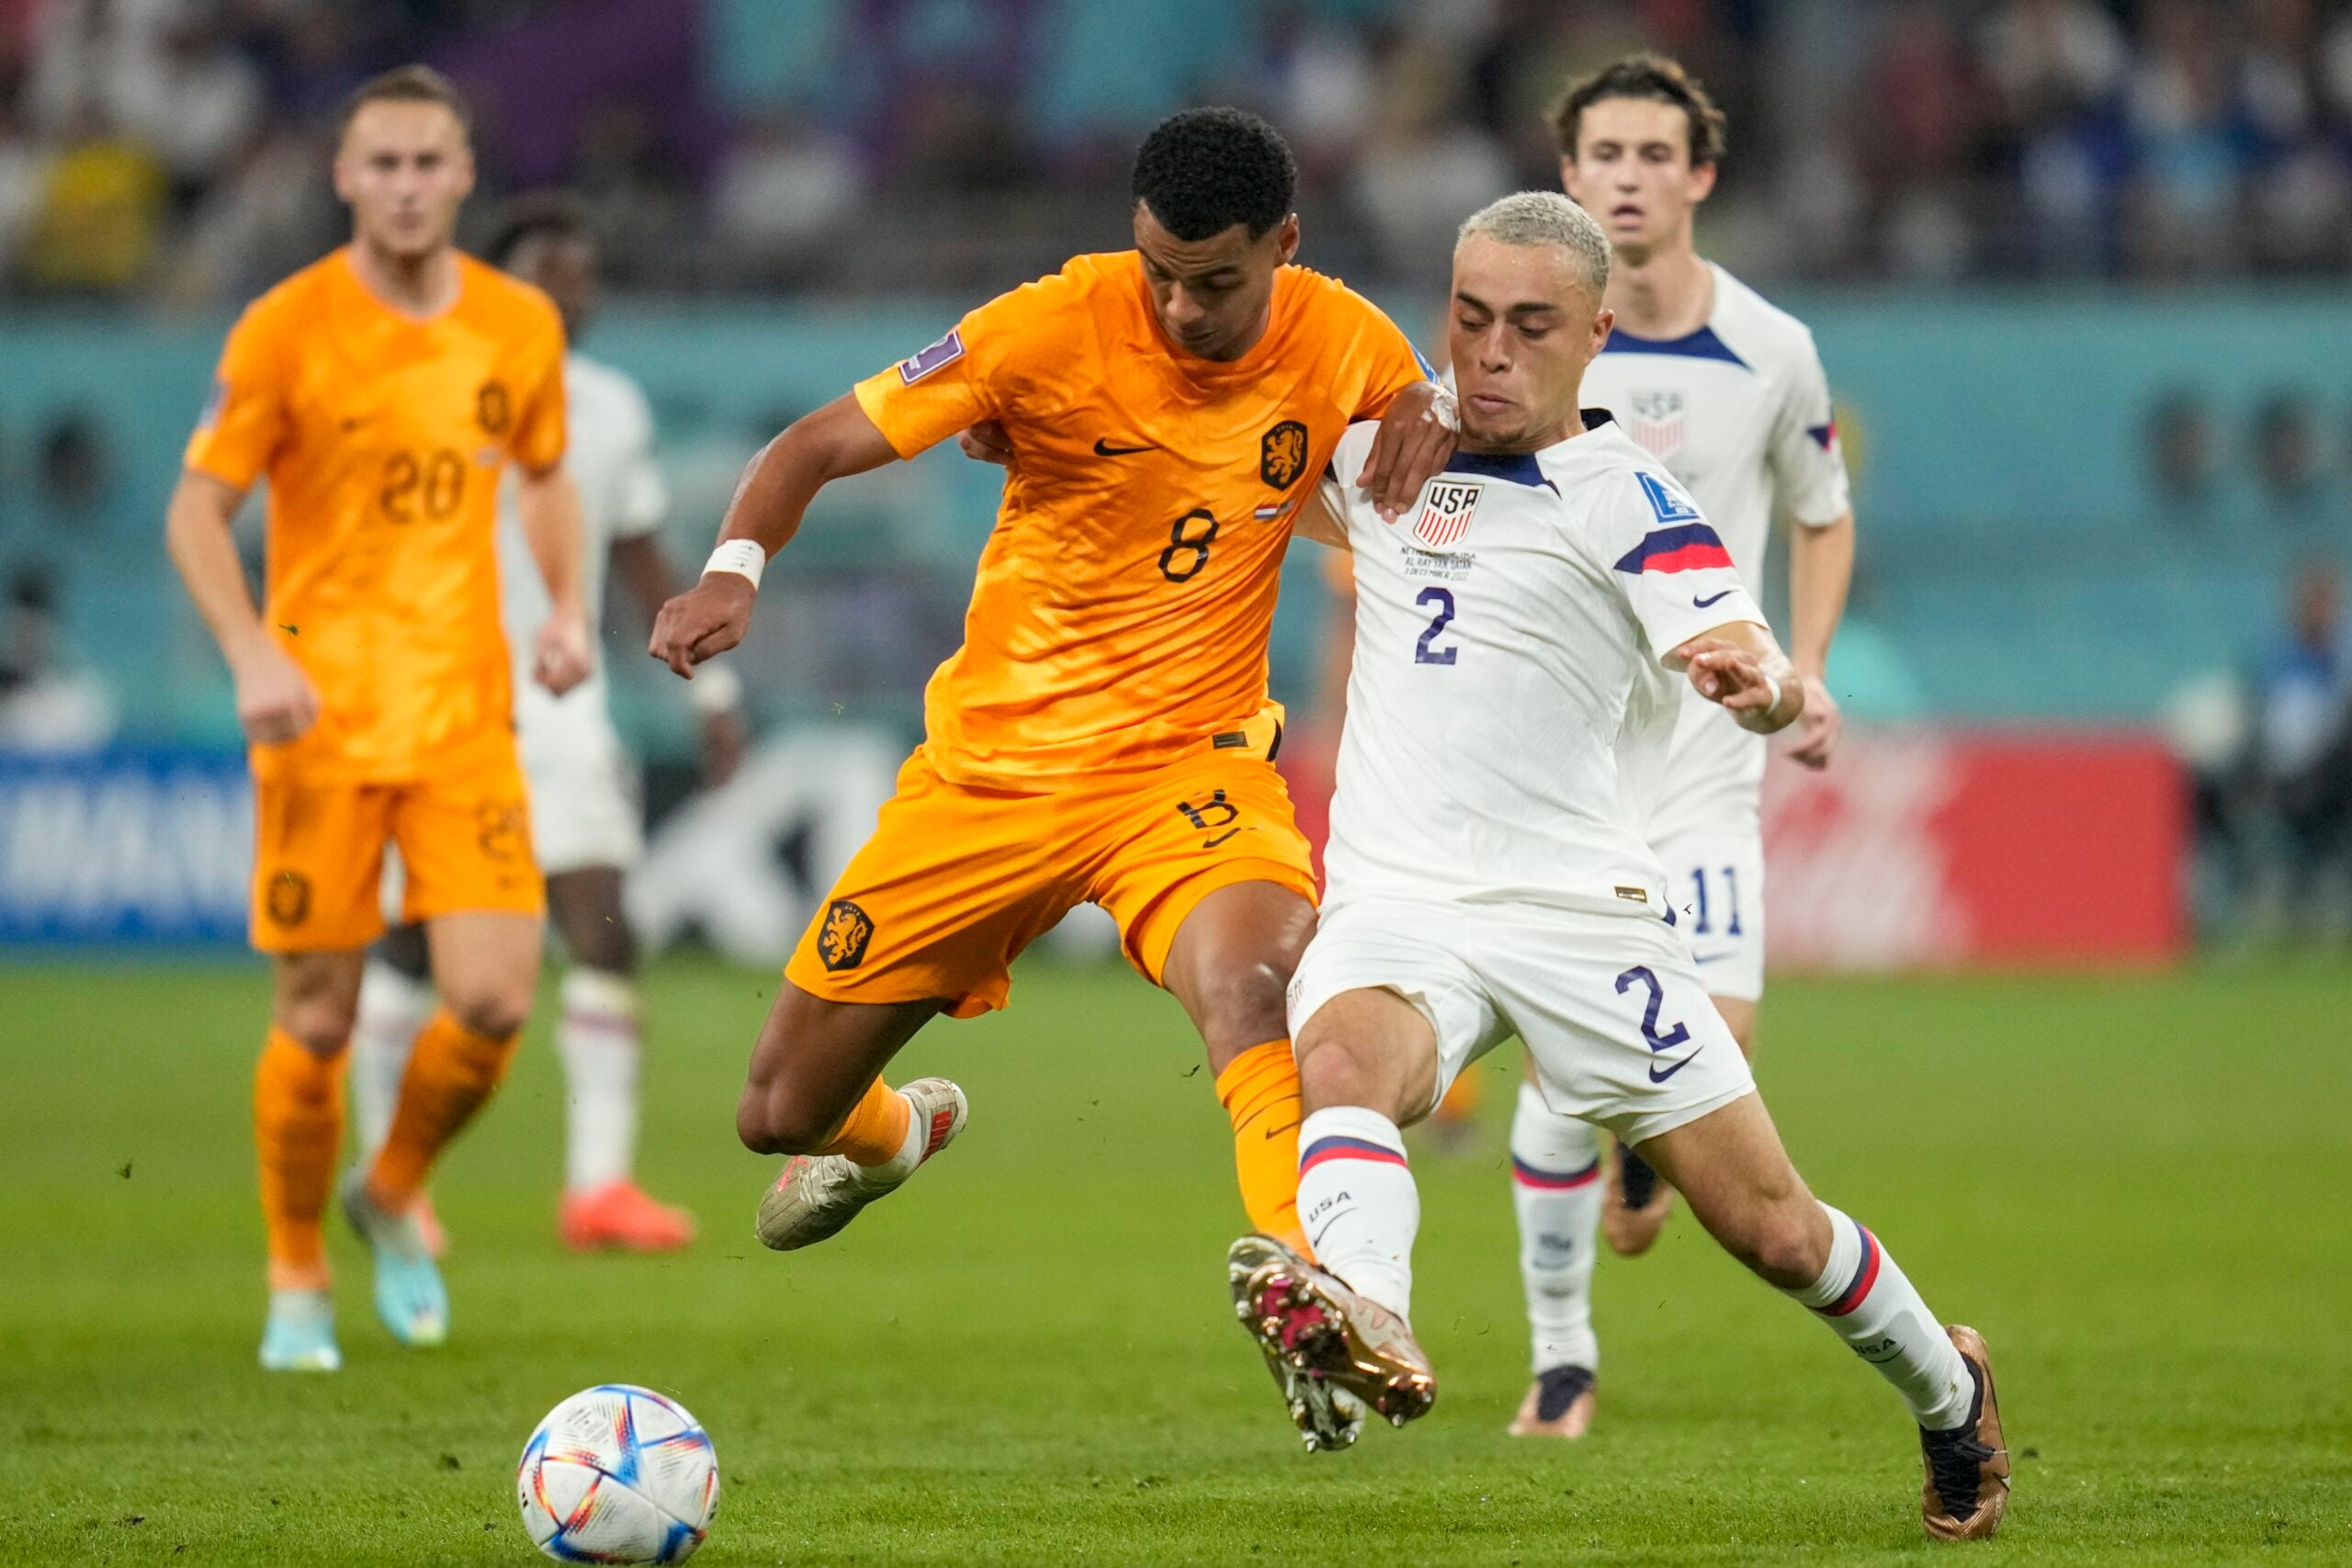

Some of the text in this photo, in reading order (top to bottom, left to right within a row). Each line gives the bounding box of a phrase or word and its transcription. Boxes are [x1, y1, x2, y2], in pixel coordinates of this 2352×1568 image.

[380, 450, 462, 525] 20
[1430, 486, 1479, 514] USA
[1159, 508, 1219, 582] 8
[1415, 587, 1458, 665] 2
[1691, 867, 1741, 934] 11
[1615, 965, 1690, 1053] 2
[1309, 1191, 1351, 1223] USA
[1851, 1338, 1896, 1354] USA
